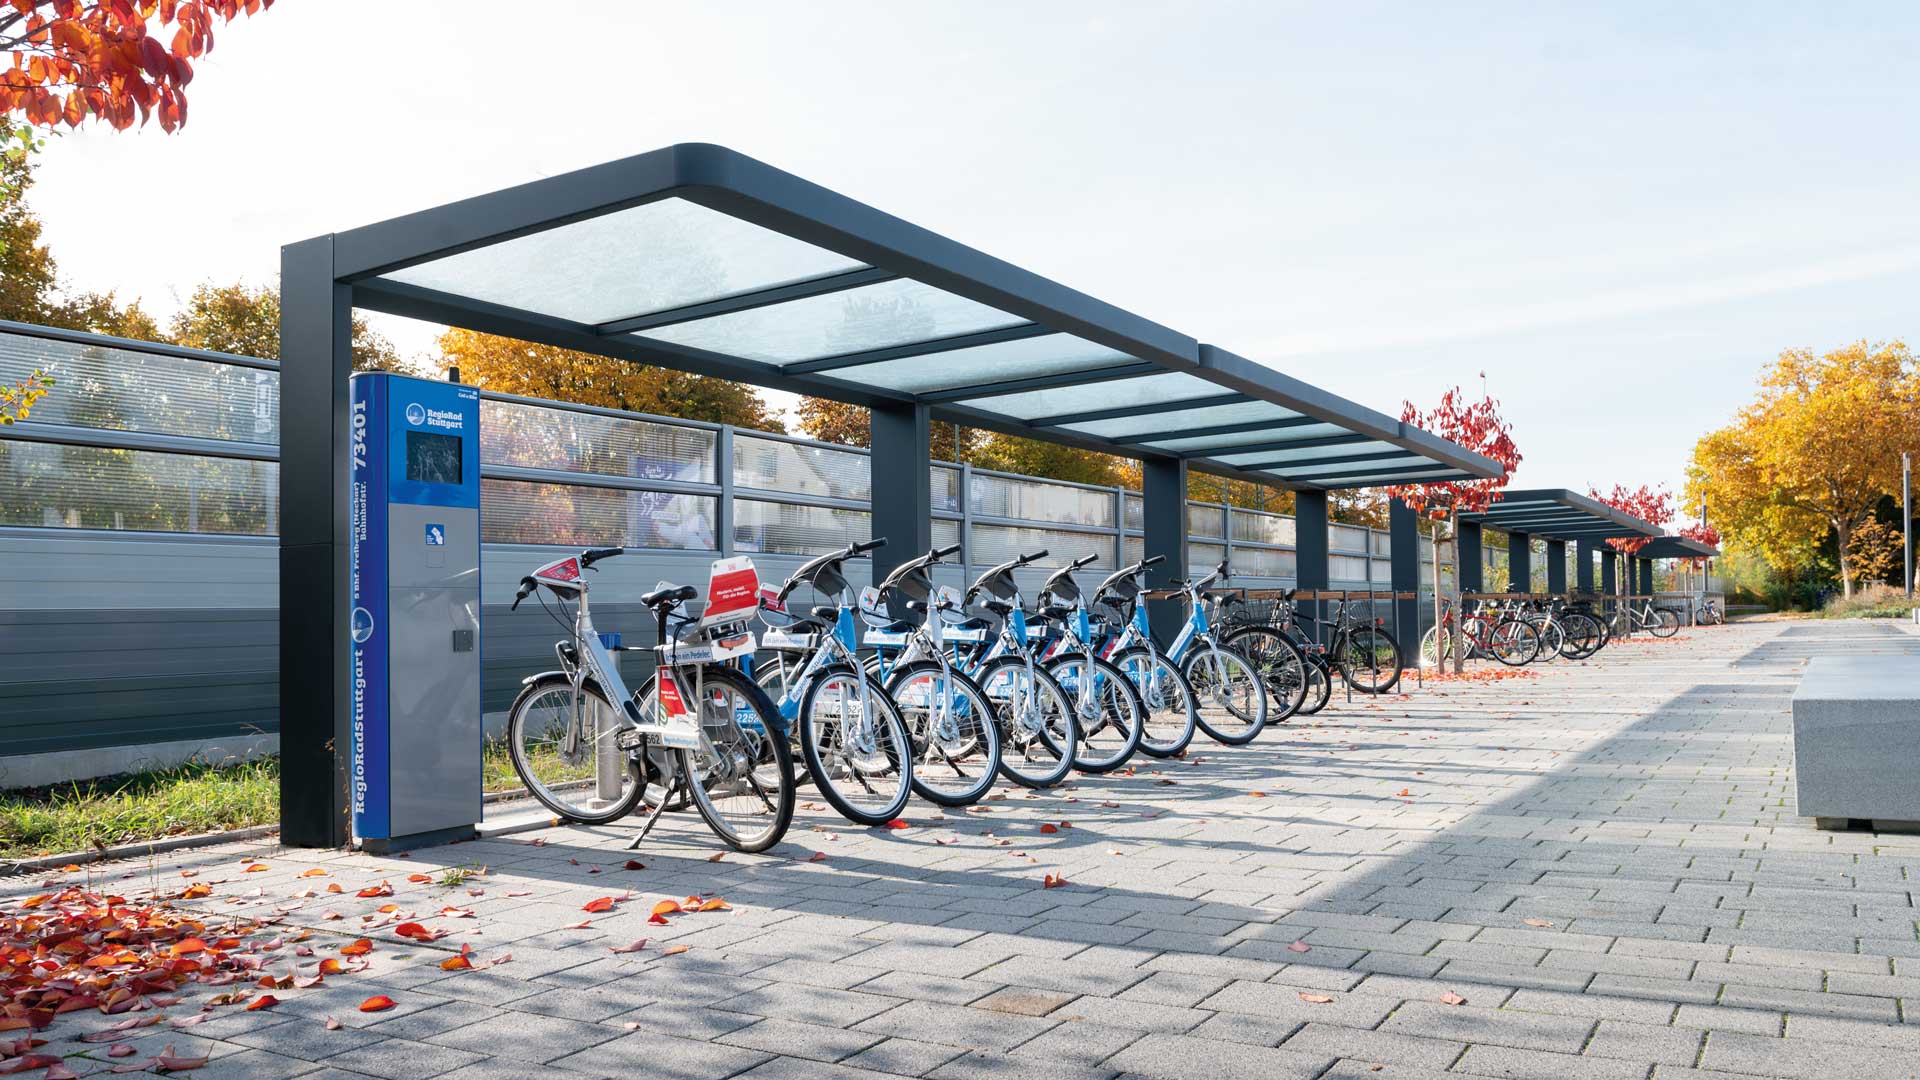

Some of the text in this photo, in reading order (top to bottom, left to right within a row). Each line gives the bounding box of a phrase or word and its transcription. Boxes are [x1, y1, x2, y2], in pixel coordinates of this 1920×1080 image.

[353, 400, 367, 470] 73401
[427, 409, 463, 421] RegioRad
[427, 417, 463, 429] Stuttgart
[353, 482, 361, 526] (Neckar)
[359, 481, 367, 541] Bahnhofstr.
[353, 526, 361, 570] Freiberg
[690, 649, 710, 659] Pedelec
[354, 649, 367, 814] RegioRadStuttgart
